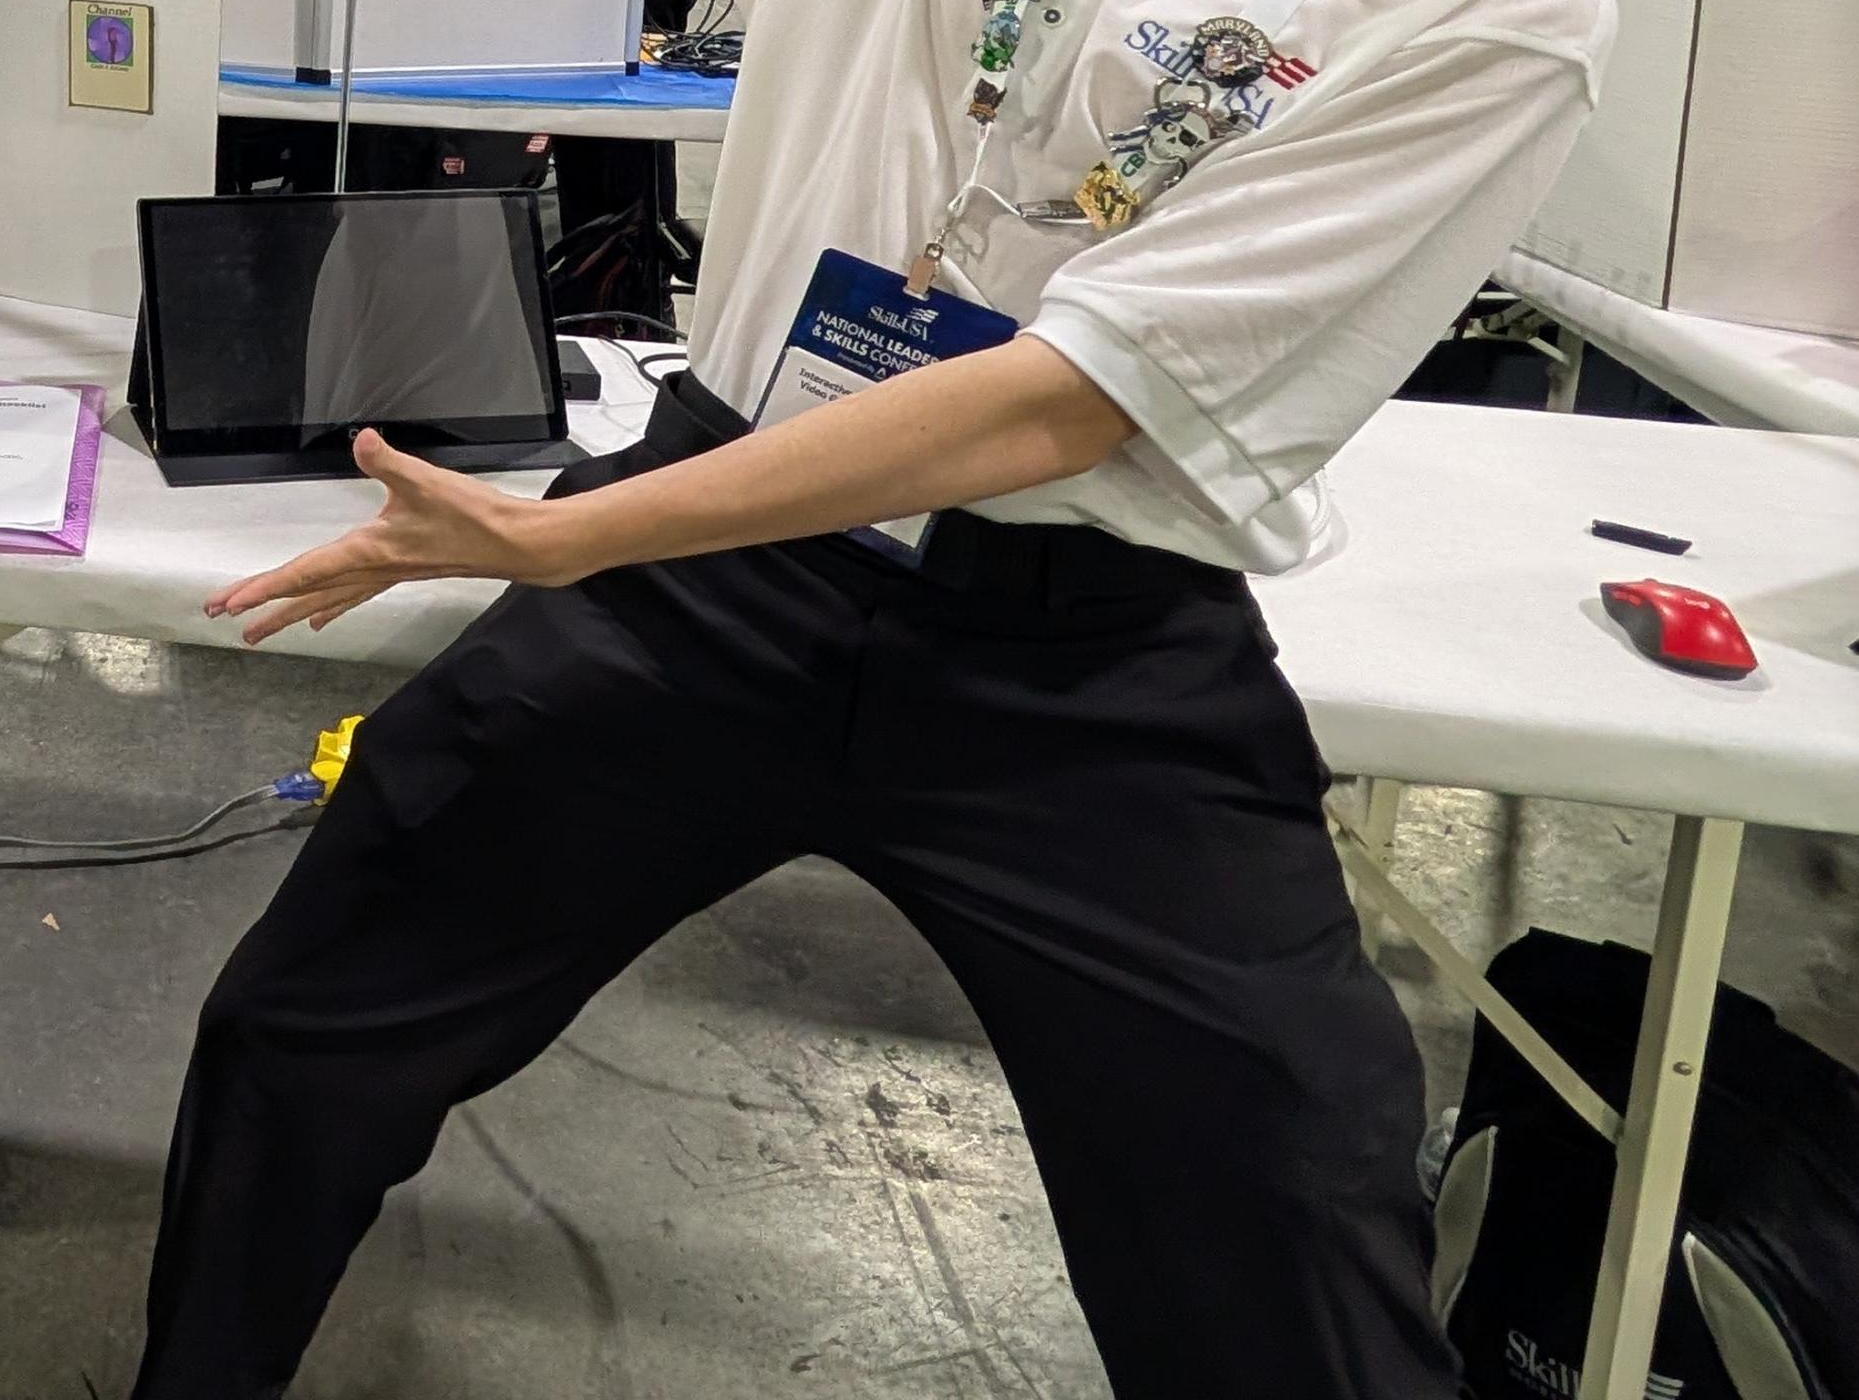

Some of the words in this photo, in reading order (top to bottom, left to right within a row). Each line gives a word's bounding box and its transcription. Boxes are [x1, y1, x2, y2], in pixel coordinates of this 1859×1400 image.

[87, 3, 133, 16] Channel
[1201, 18, 1270, 57] MARYLAND
[1120, 152, 1146, 178] CB
[812, 324, 822, 337] &
[824, 329, 869, 356] SKILLS
[817, 310, 885, 347] NATIONAL
[868, 305, 928, 341] SkillsUSA
[799, 380, 827, 400] Video
[1506, 1329, 1580, 1400] Skill
